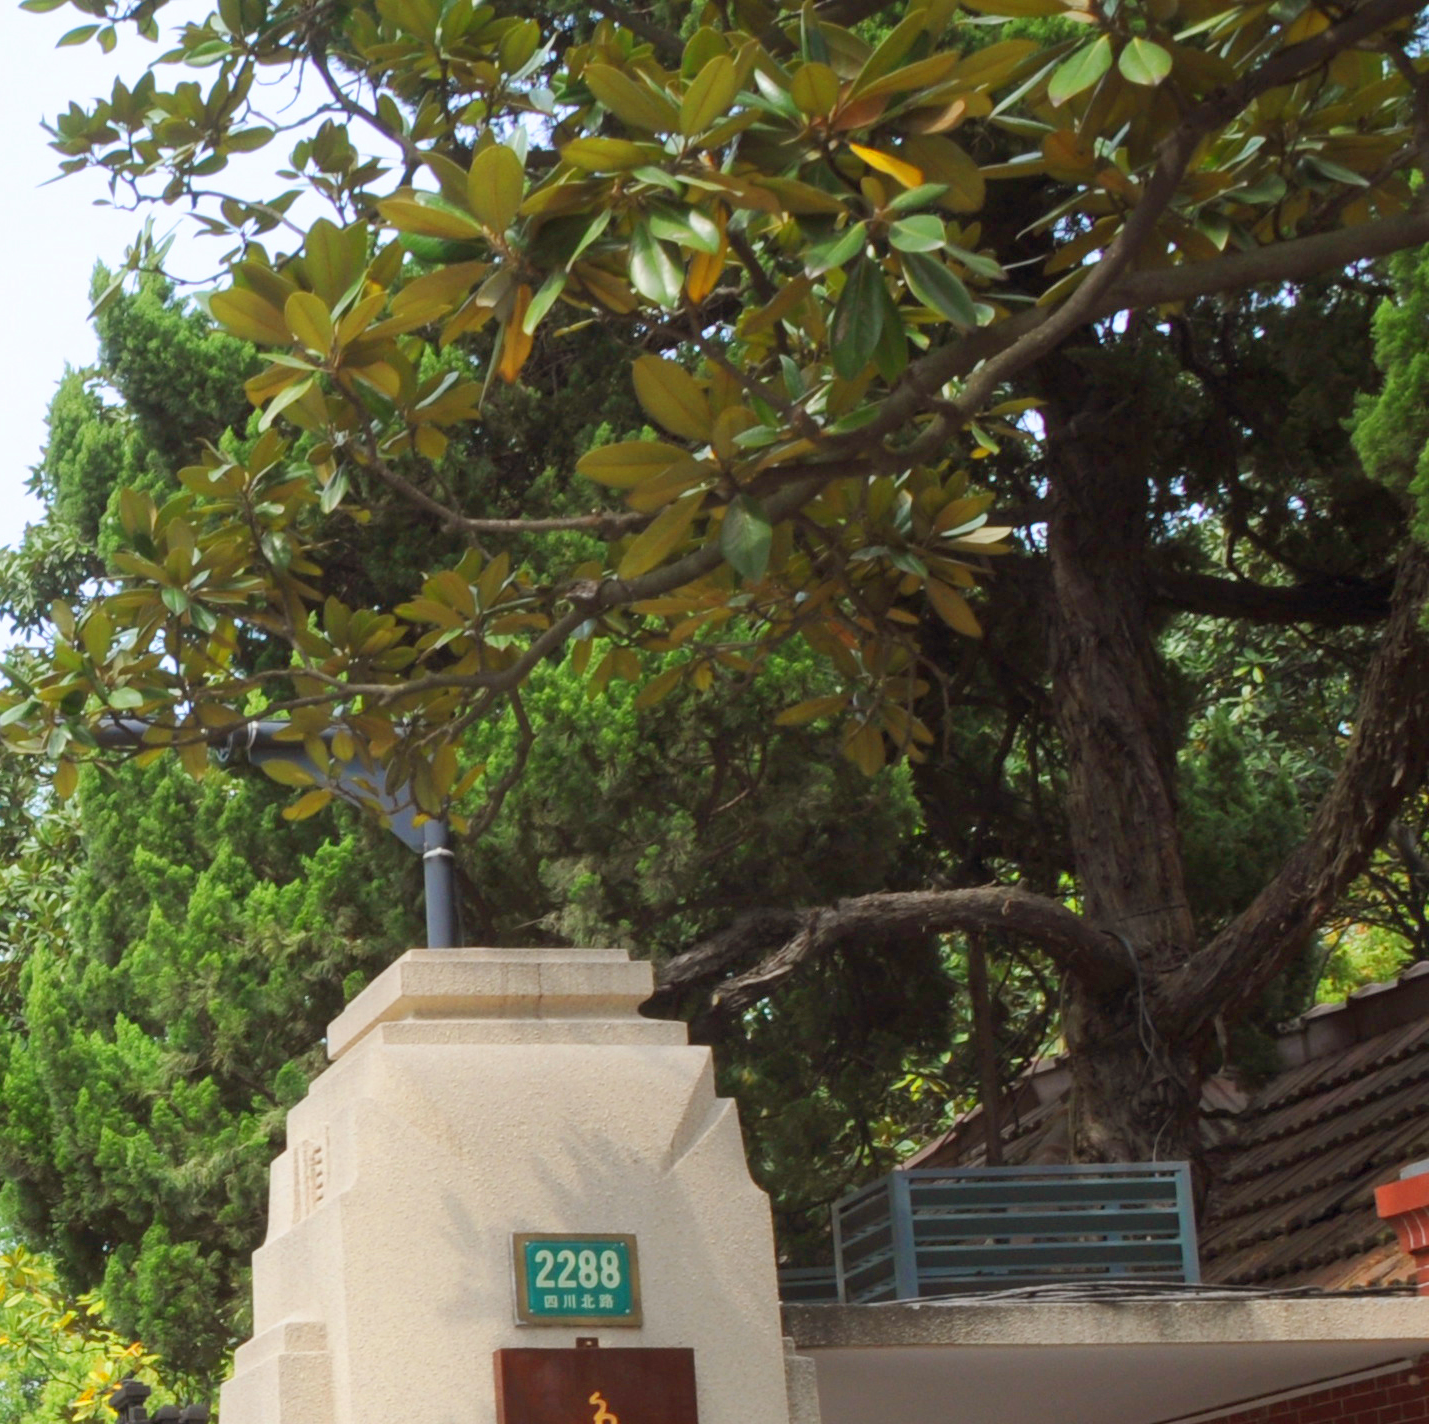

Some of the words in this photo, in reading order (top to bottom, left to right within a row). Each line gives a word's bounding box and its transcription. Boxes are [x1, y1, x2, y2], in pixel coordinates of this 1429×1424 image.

[534, 1249, 621, 1289] 2288
[543, 1293, 614, 1309] 四川北路
